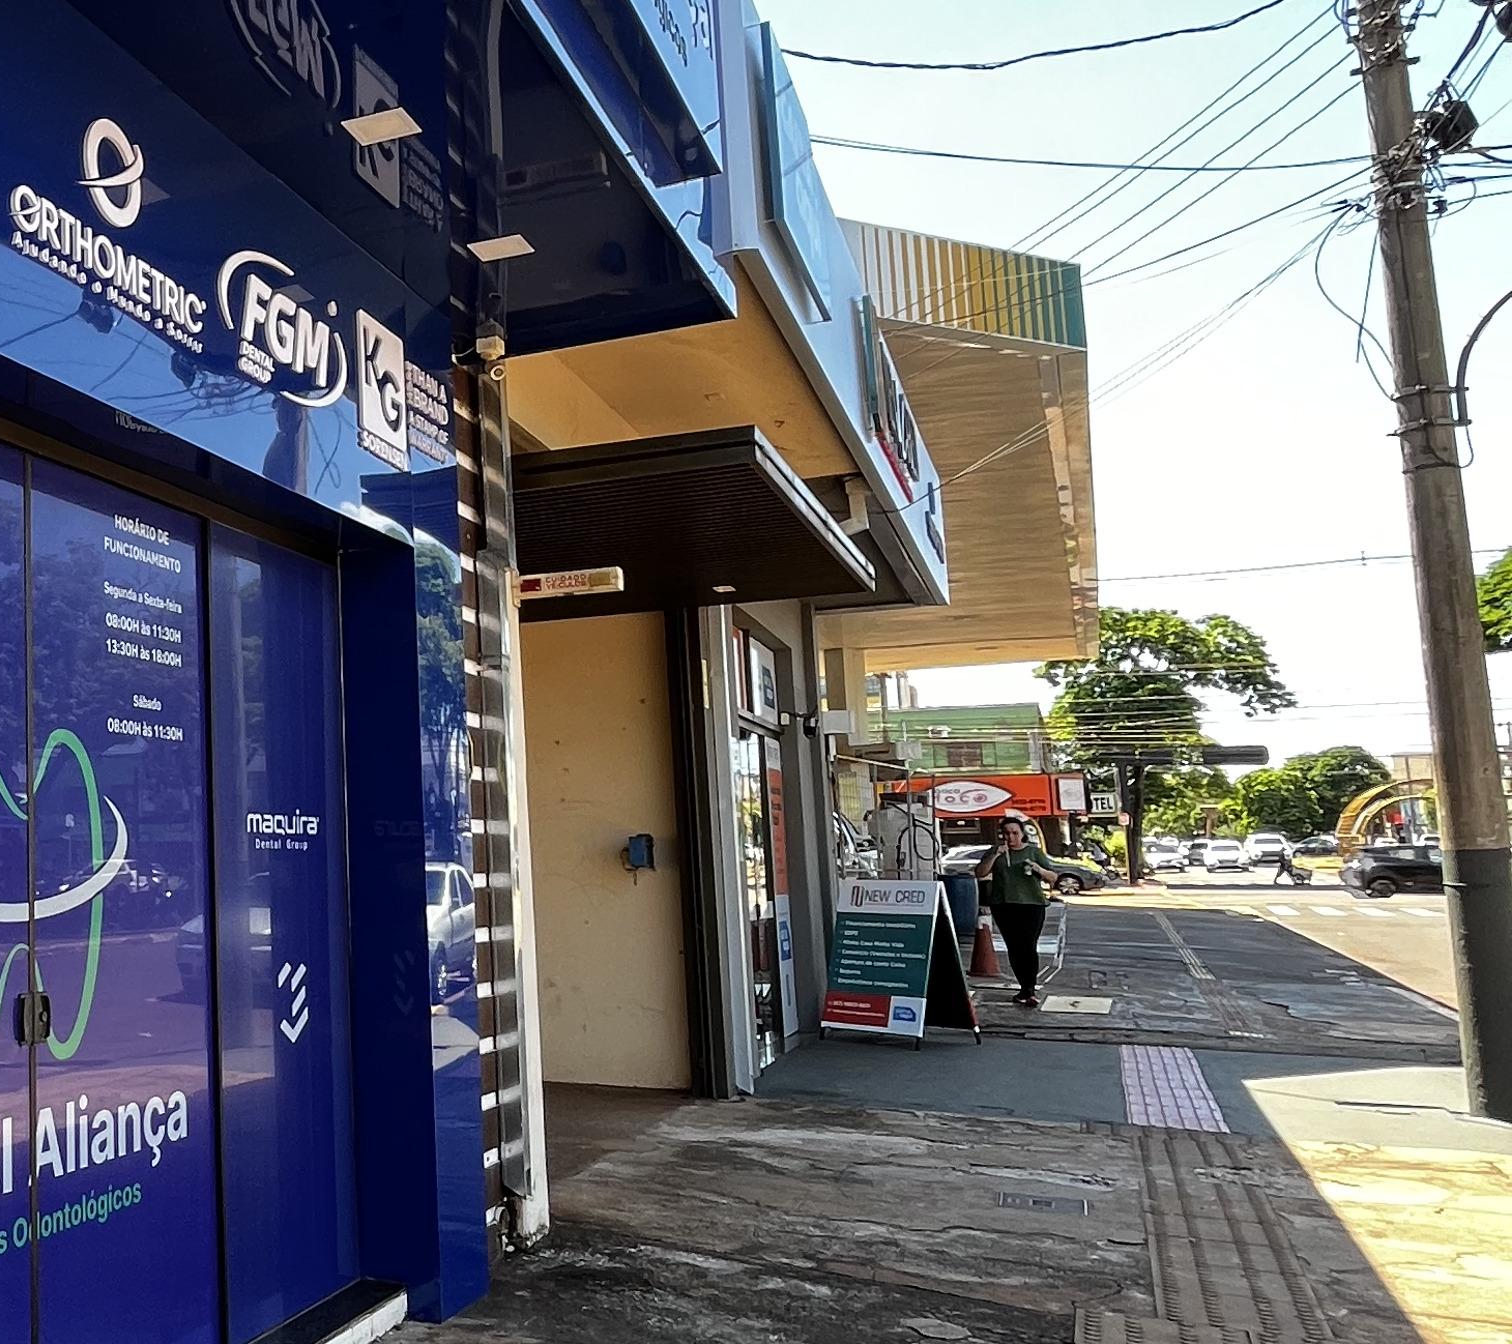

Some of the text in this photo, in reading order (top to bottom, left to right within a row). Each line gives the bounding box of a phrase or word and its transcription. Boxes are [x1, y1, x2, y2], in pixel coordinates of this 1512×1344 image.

[8, 184, 205, 334] ORTHOMETRIC
[11, 231, 87, 285] Ajudando
[91, 281, 103, 293] o
[106, 286, 151, 322] Mundo
[153, 317, 164, 330] a
[240, 273, 331, 388] FGM
[237, 356, 273, 384] GROUP
[239, 340, 276, 373] DENTAL
[114, 514, 170, 546] HORÁRIO DE
[103, 536, 181, 574] FUNCIONAMENTO
[103, 581, 137, 603] Segunda
[545, 573, 587, 583] CUIDADO
[105, 611, 140, 634] 08:00H
[152, 624, 182, 644] 11:30H
[105, 638, 139, 658] 13:30H
[151, 648, 182, 668] 18:00H
[133, 694, 162, 712] Sábado
[107, 717, 142, 737] 08:00H
[154, 723, 184, 742] 11:30H
[246, 809, 319, 835] maquira
[255, 838, 309, 851] Dental Group
[864, 889, 926, 904] NEW CRED
[28, 1089, 189, 1188] Aliança
[12, 1181, 143, 1249] Odontológicos
